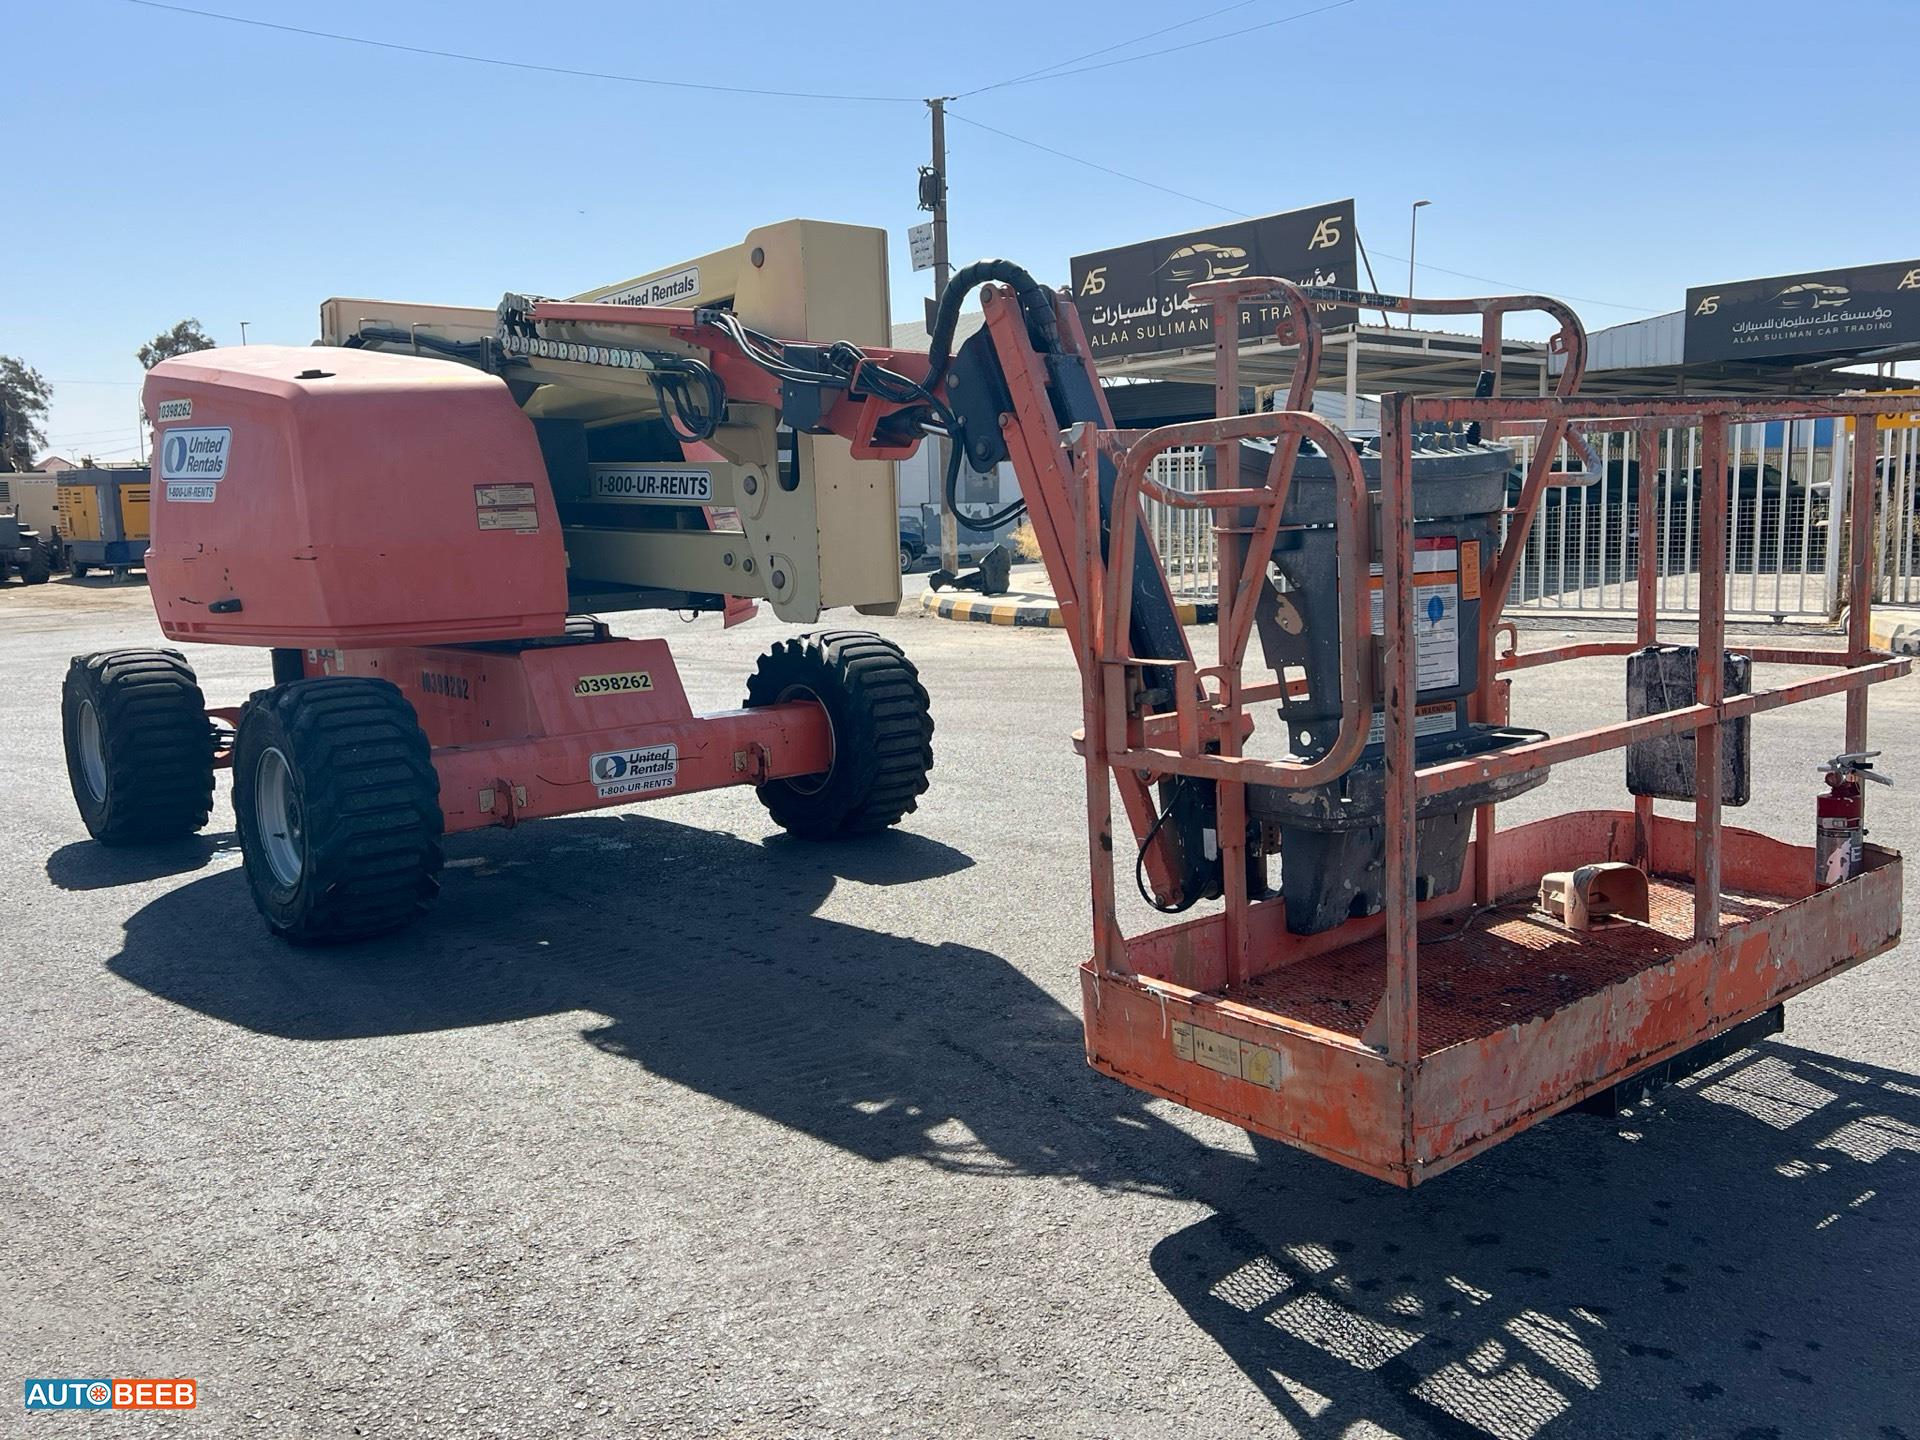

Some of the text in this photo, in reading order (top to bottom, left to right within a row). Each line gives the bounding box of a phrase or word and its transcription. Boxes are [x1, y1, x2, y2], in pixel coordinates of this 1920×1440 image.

[651, 275, 695, 303] Rentals
[1091, 296, 1159, 327] للسيارات
[1259, 302, 1338, 321] TRANG
[1840, 306, 1893, 321] مؤسسة
[1732, 318, 1775, 334] للسيارات
[1774, 315, 1814, 328] سليمان
[1091, 317, 1210, 348] ALAA SULIMAN
[1732, 321, 1893, 344] ALAA SULIMAN CAR TRADING
[188, 436, 225, 454] United
[186, 455, 223, 473] Rentals
[168, 486, 214, 498] 1-800-UR-RENTS
[597, 475, 709, 496] 1-800-UR-RENTS
[1421, 702, 1453, 715] WARNING
[629, 749, 670, 765] United
[629, 760, 674, 776] Rentals
[600, 777, 673, 796] 1-800-UR-RENTS
